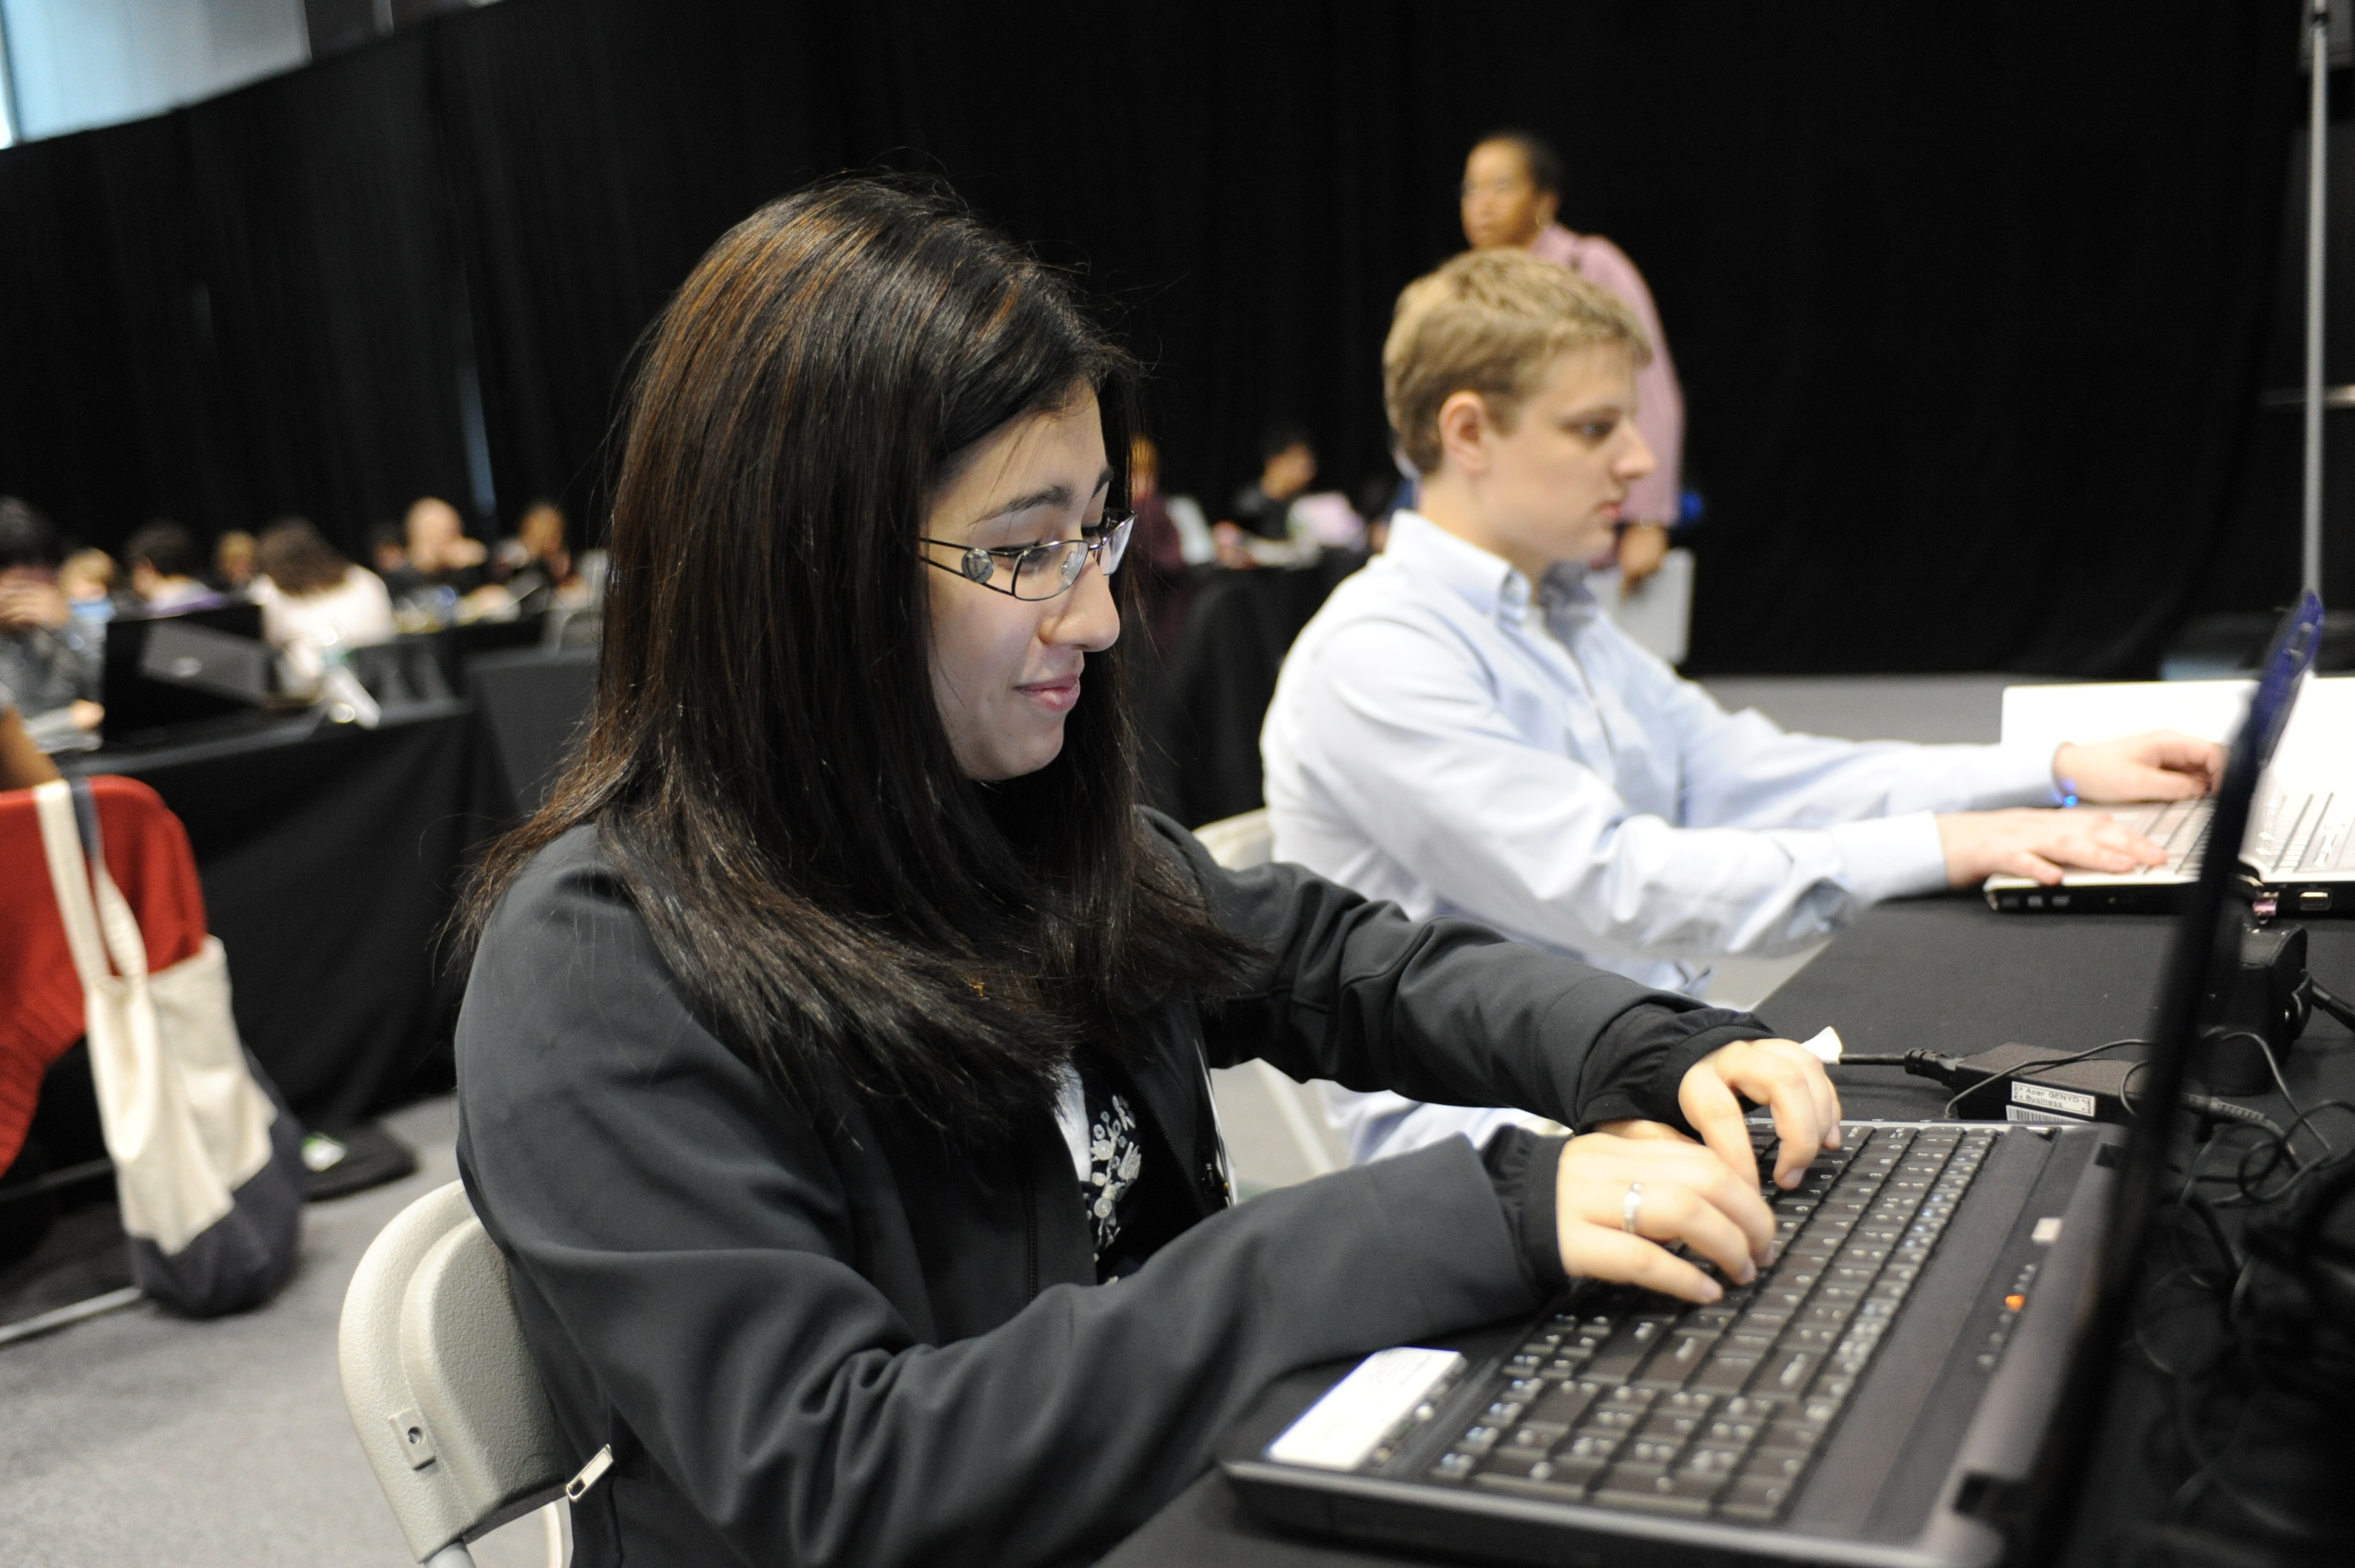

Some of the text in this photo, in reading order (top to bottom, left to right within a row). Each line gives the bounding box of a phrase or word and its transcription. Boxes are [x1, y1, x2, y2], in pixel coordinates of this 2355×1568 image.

[2025, 1095, 2064, 1108] Business
[2026, 1088, 2079, 1104] Acer GENYD
